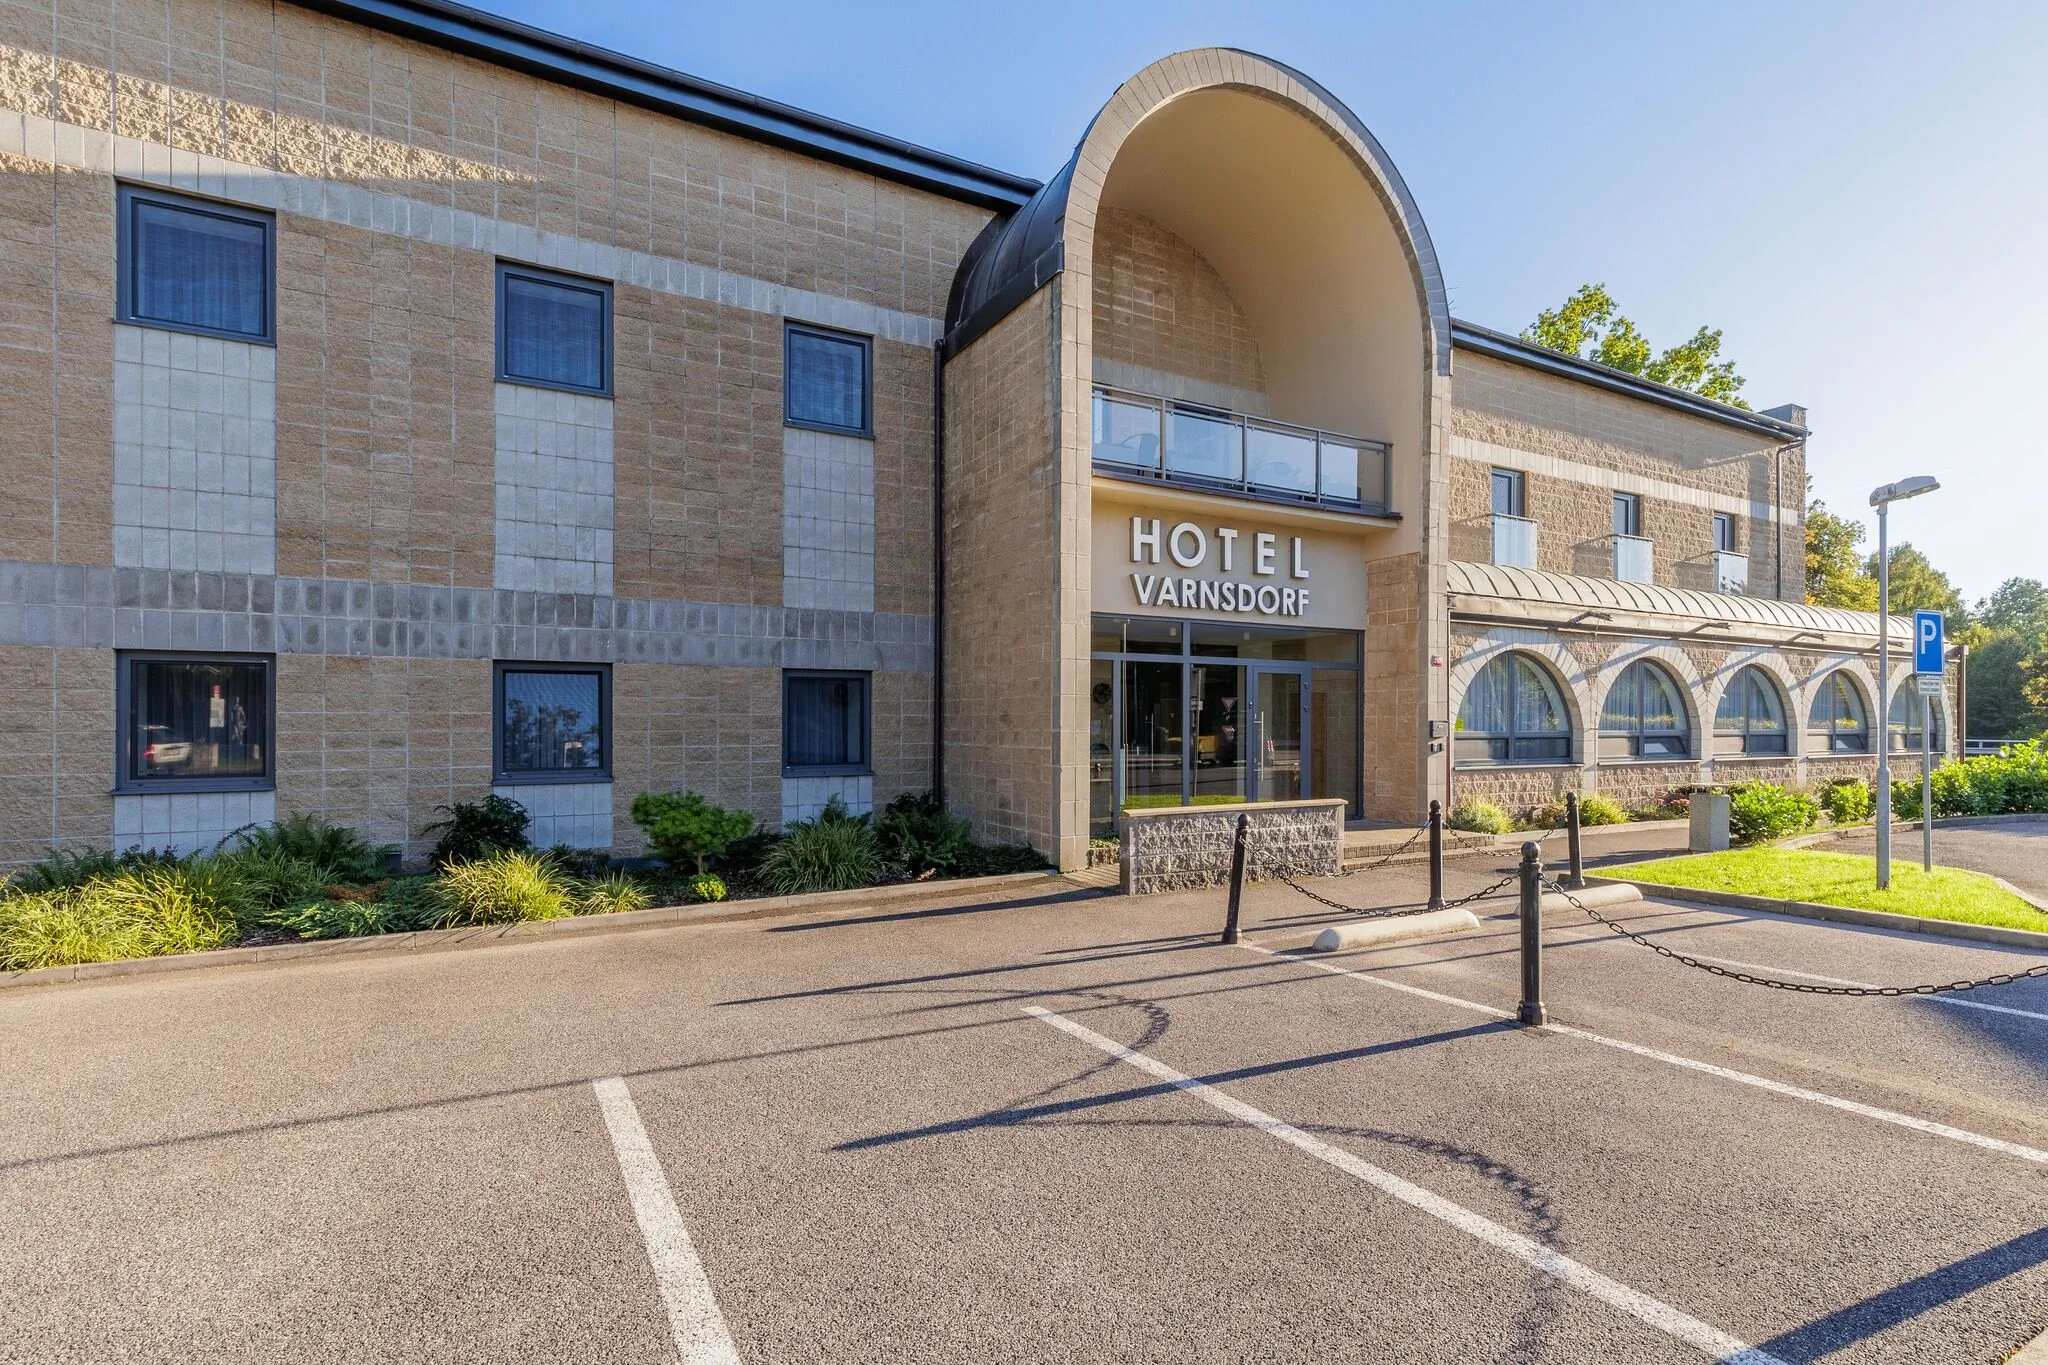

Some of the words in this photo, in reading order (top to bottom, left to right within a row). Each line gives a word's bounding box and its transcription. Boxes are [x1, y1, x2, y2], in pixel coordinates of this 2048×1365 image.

[1130, 516, 1309, 579] HOTEL
[1130, 573, 1309, 616] VARNSDORF
[1920, 619, 1937, 654] P
